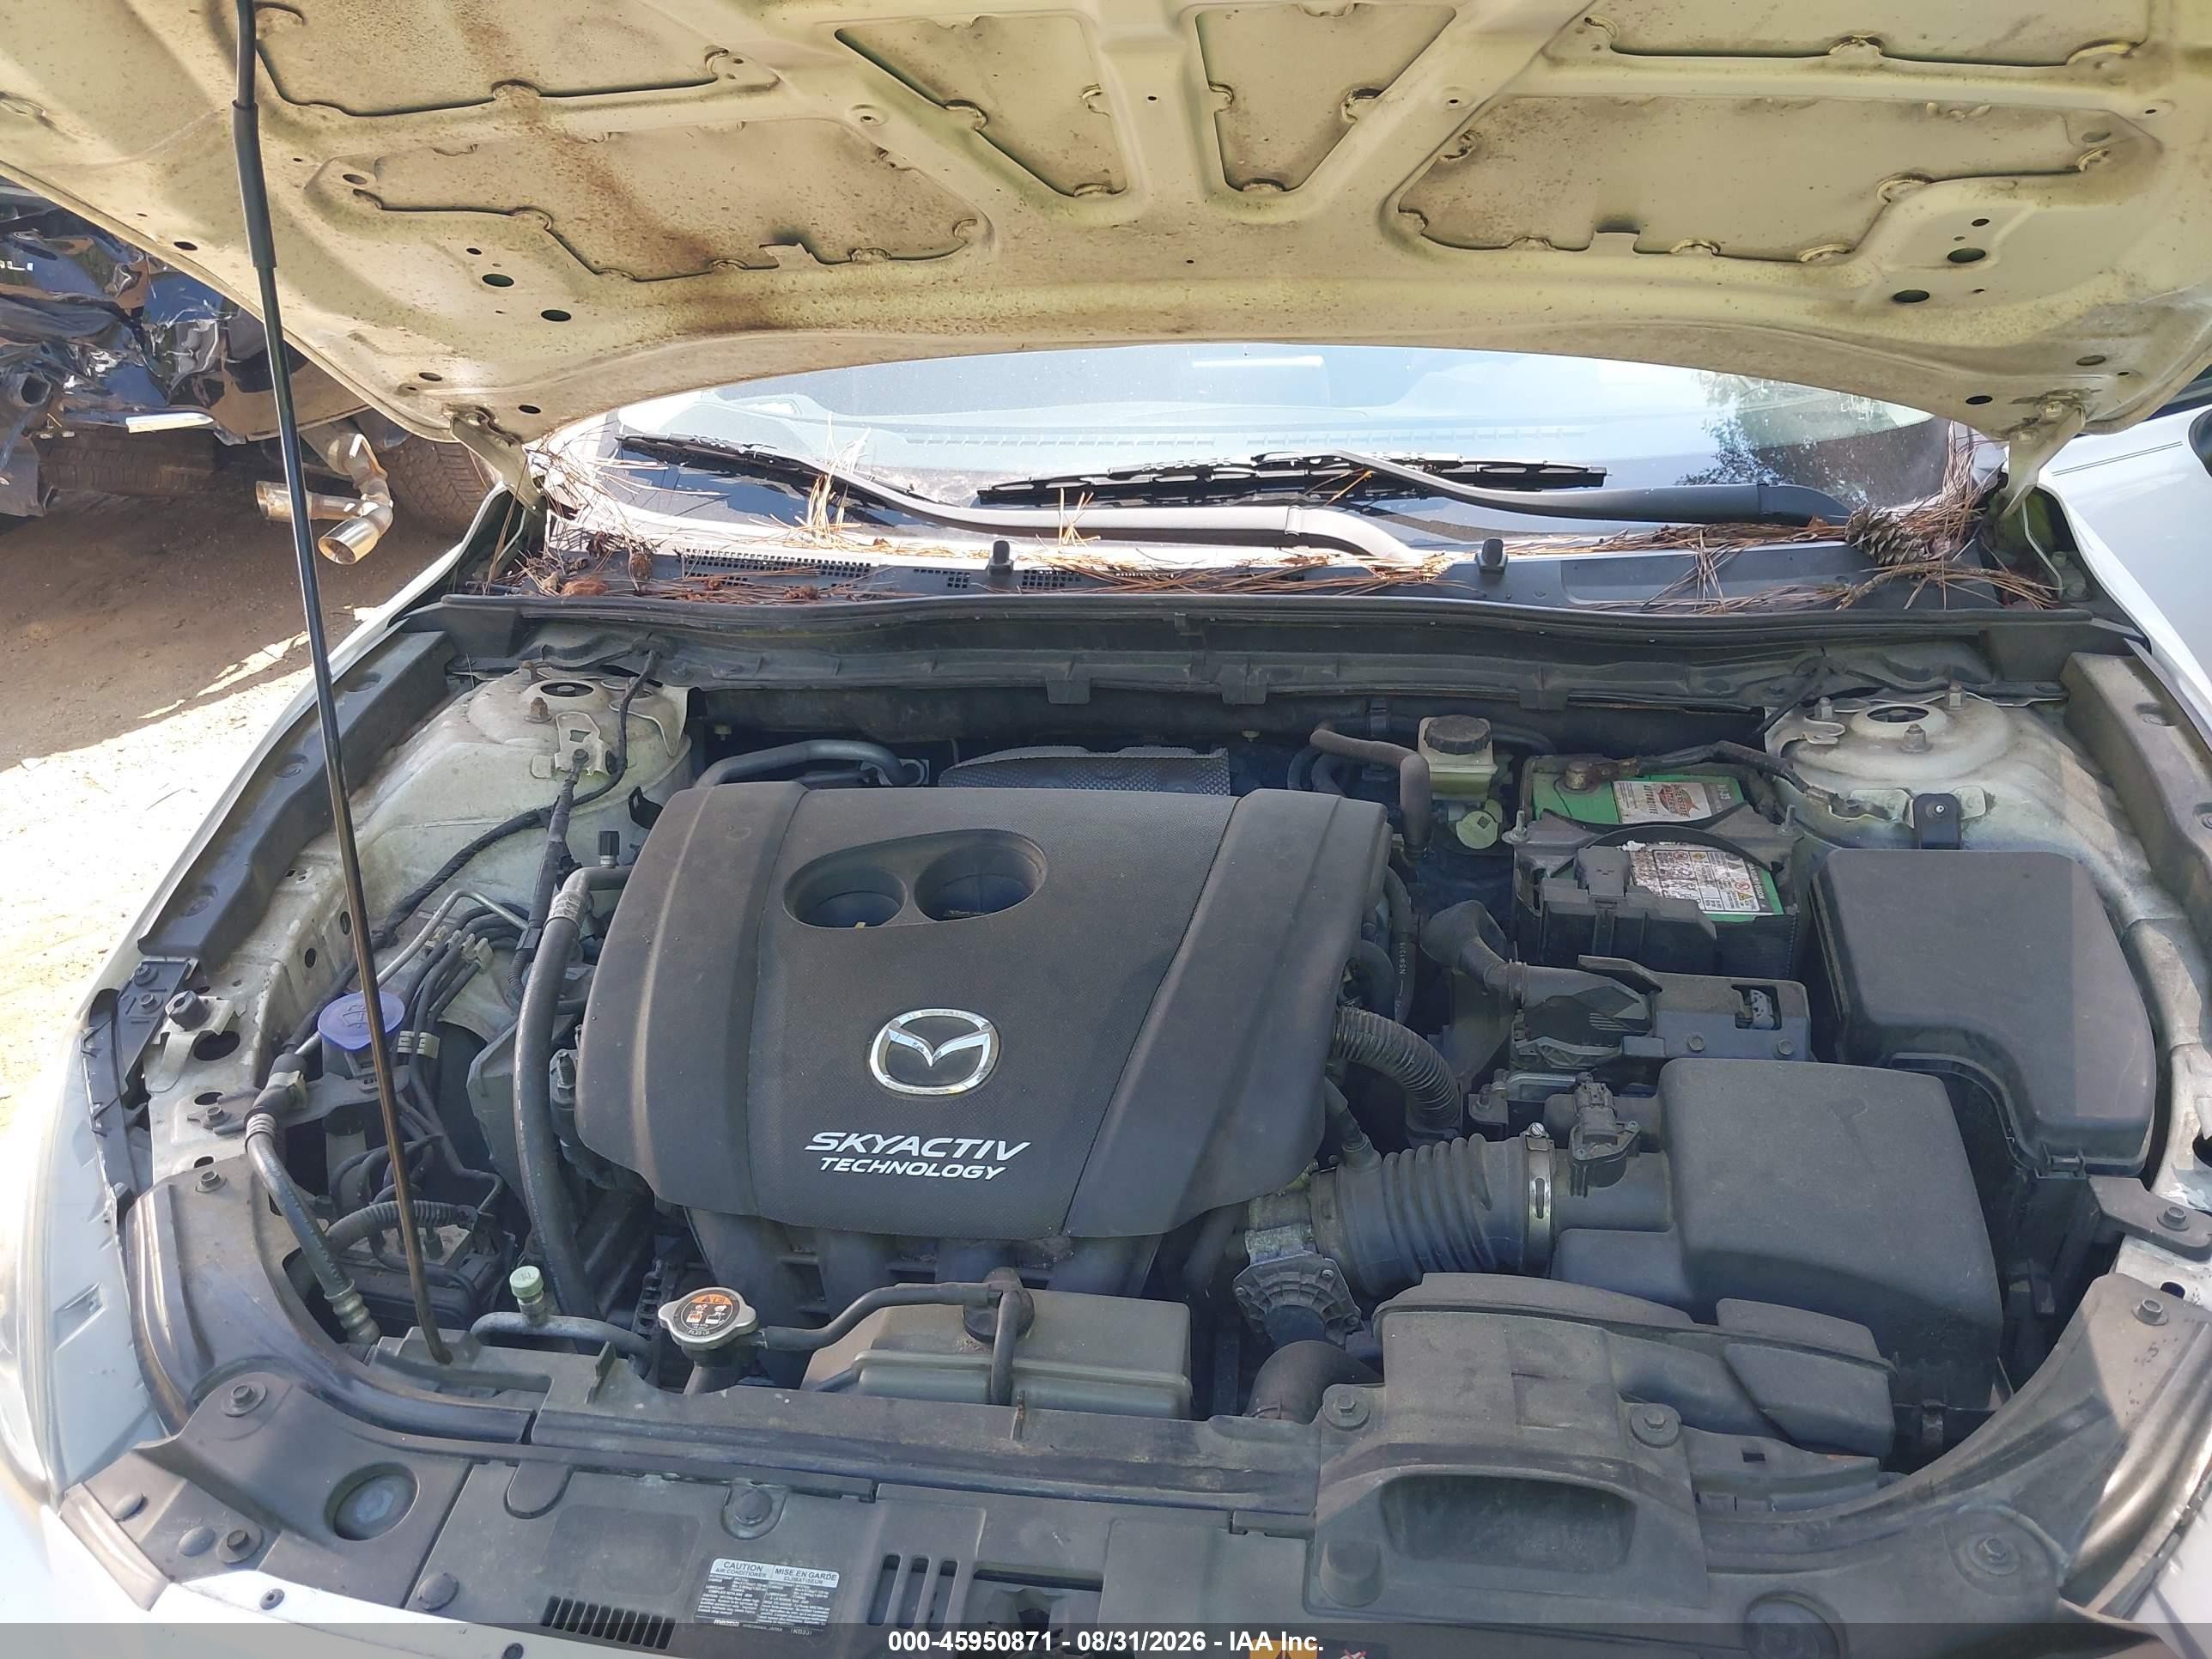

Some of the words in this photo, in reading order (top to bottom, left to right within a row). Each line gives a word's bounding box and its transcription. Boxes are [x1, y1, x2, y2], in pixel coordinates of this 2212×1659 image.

[1643, 785, 1658, 815] AUTOMOTIVE
[804, 1132, 1031, 1161] SKYACTIV
[820, 1157, 1006, 1180] TECHNOLOGY
[723, 1561, 763, 1572] CAUTION
[808, 1571, 837, 1582] GARDE
